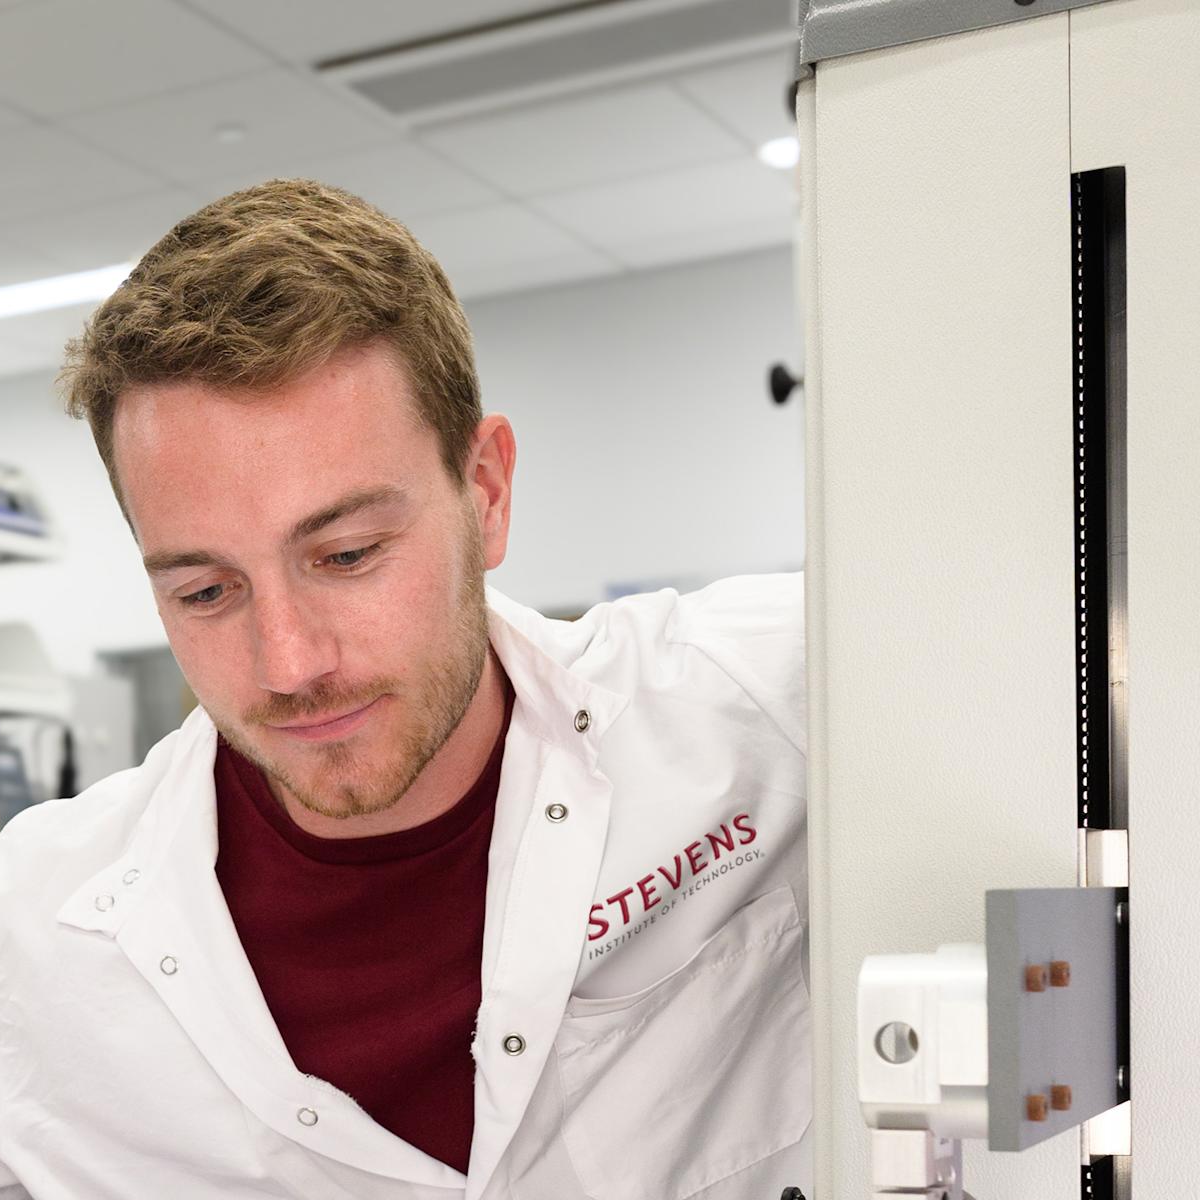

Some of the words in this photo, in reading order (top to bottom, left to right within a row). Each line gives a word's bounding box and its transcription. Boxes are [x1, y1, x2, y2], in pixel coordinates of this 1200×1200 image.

[587, 812, 757, 942] STEVENS
[588, 912, 656, 960] INSTITUTE
[660, 899, 678, 916] OF
[681, 849, 762, 901] TECHNOLOGY
